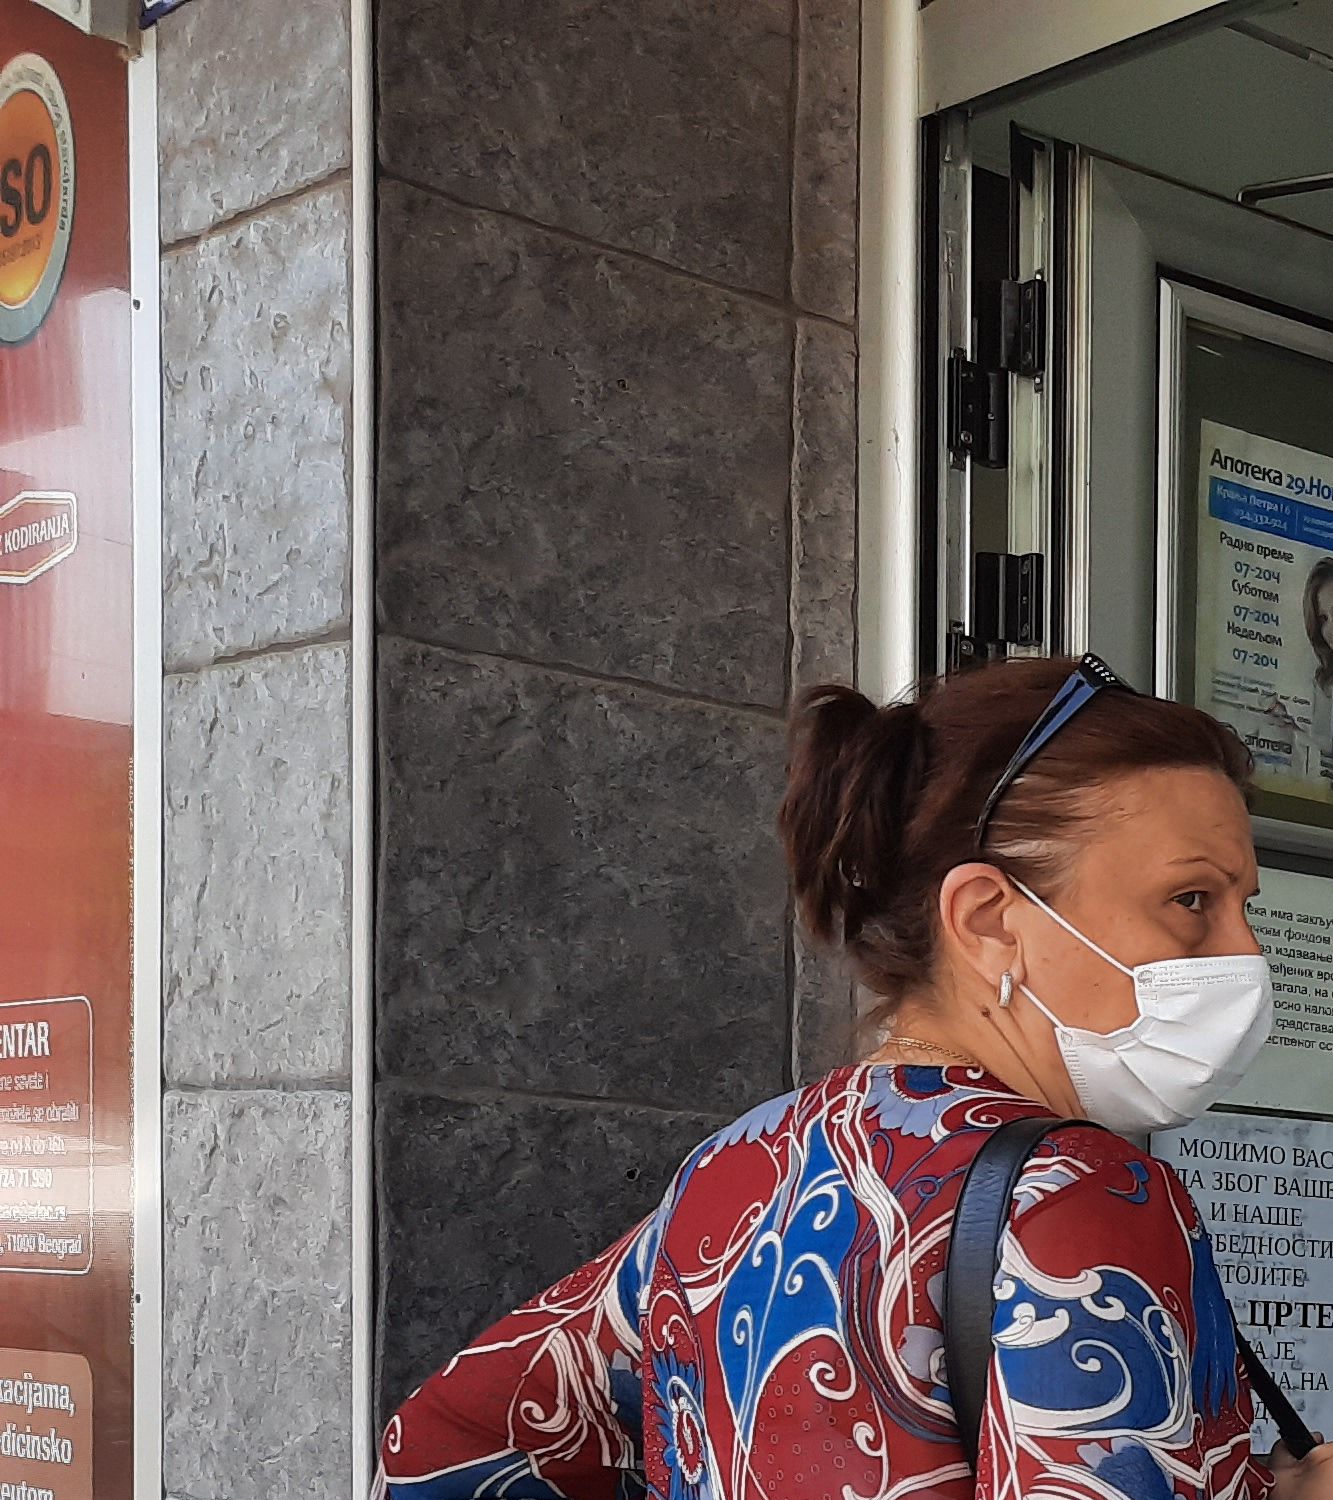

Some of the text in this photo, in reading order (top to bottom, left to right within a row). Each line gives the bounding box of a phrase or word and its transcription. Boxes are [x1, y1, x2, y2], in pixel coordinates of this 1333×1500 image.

[1211, 448, 1283, 486] Апотека
[4, 512, 70, 554] KODIRANJA
[1220, 531, 1294, 563] Радно време
[1232, 579, 1279, 603] Суботом
[1227, 621, 1282, 647] Недељом
[1271, 909, 1293, 922] има
[1284, 928, 1331, 944] фондом
[1275, 946, 1332, 963] издавање
[1315, 988, 1328, 998] на
[1274, 1001, 1301, 1012] осно
[1179, 1137, 1286, 1165] МОЛИМО
[1212, 1171, 1268, 1194] ЗБОГ
[1210, 1201, 1303, 1228] И НАШЕ
[1274, 1342, 1296, 1361] ЈЕ
[1301, 1373, 1330, 1392] НА
